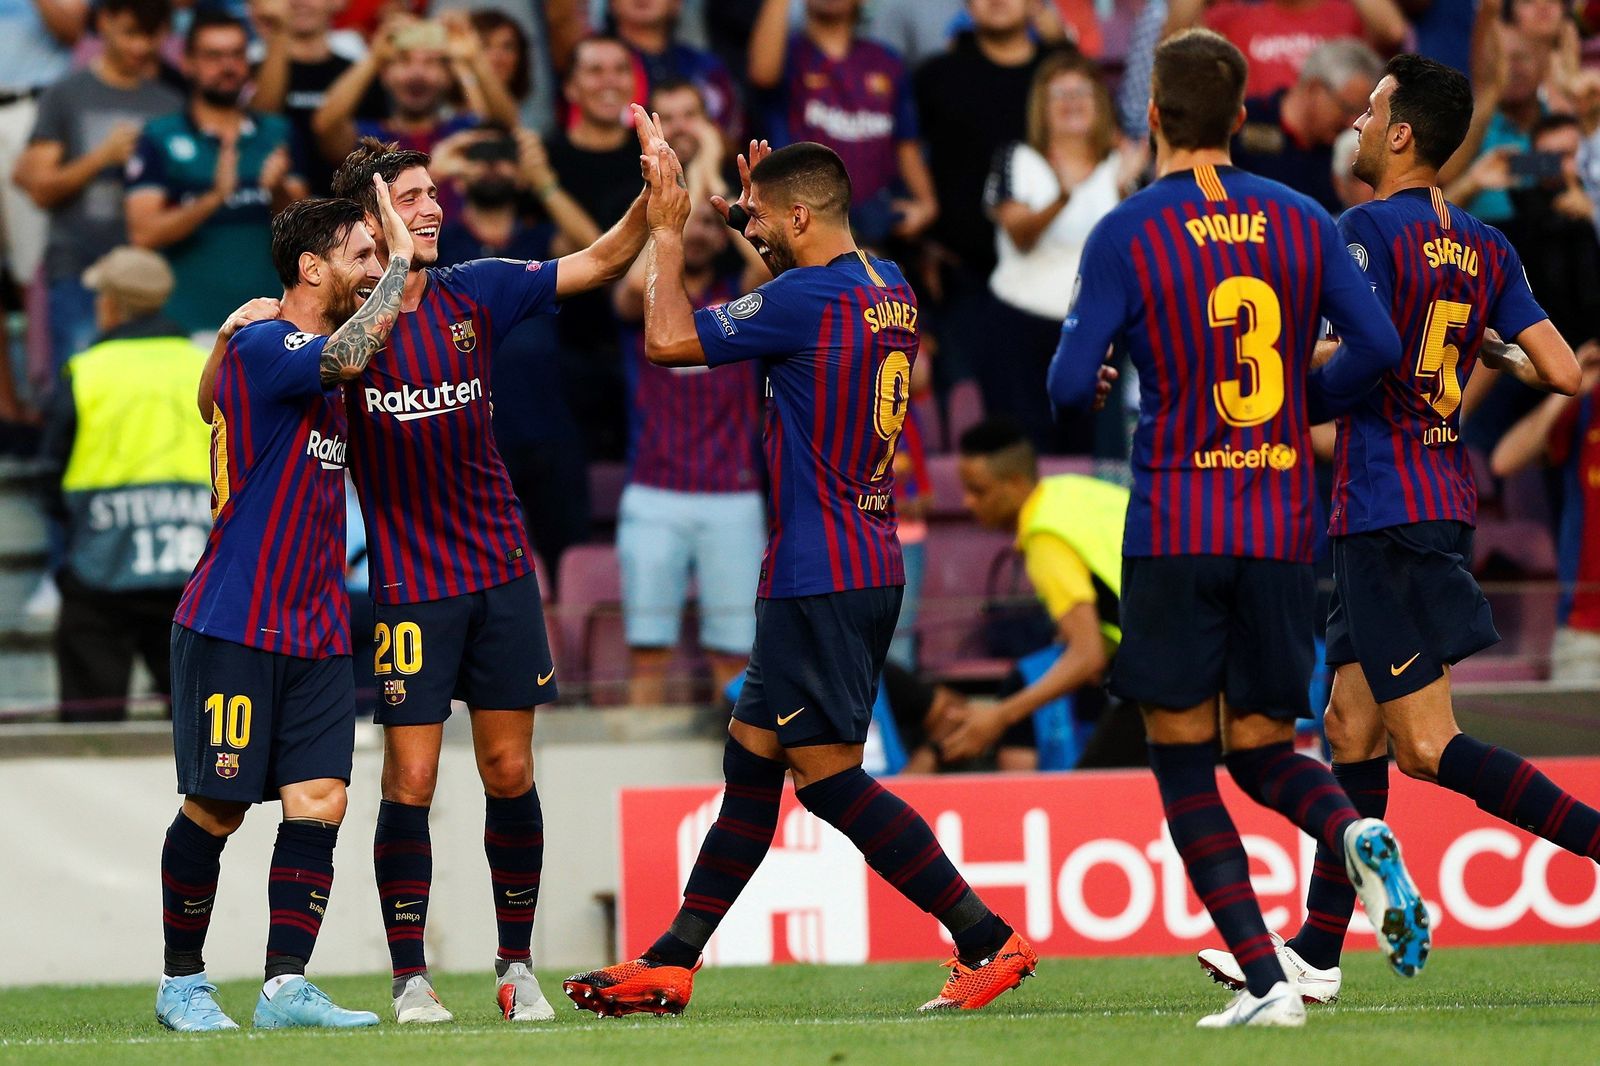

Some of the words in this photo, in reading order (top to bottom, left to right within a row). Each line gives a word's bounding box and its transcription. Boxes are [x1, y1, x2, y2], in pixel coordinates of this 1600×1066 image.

[1185, 210, 1268, 248] PIQUÉ
[1422, 237, 1479, 277] SERGIO
[864, 296, 918, 334] SUÁREZ
[1207, 275, 1285, 427] 3
[1414, 299, 1472, 419] 5
[364, 377, 482, 414] Rakuten
[870, 350, 911, 482] 9
[1194, 443, 1271, 470] unicef
[374, 621, 423, 675] 20
[204, 693, 252, 749] 10
[936, 808, 1600, 942] Hote.co
[395, 912, 421, 922] BARÇA
